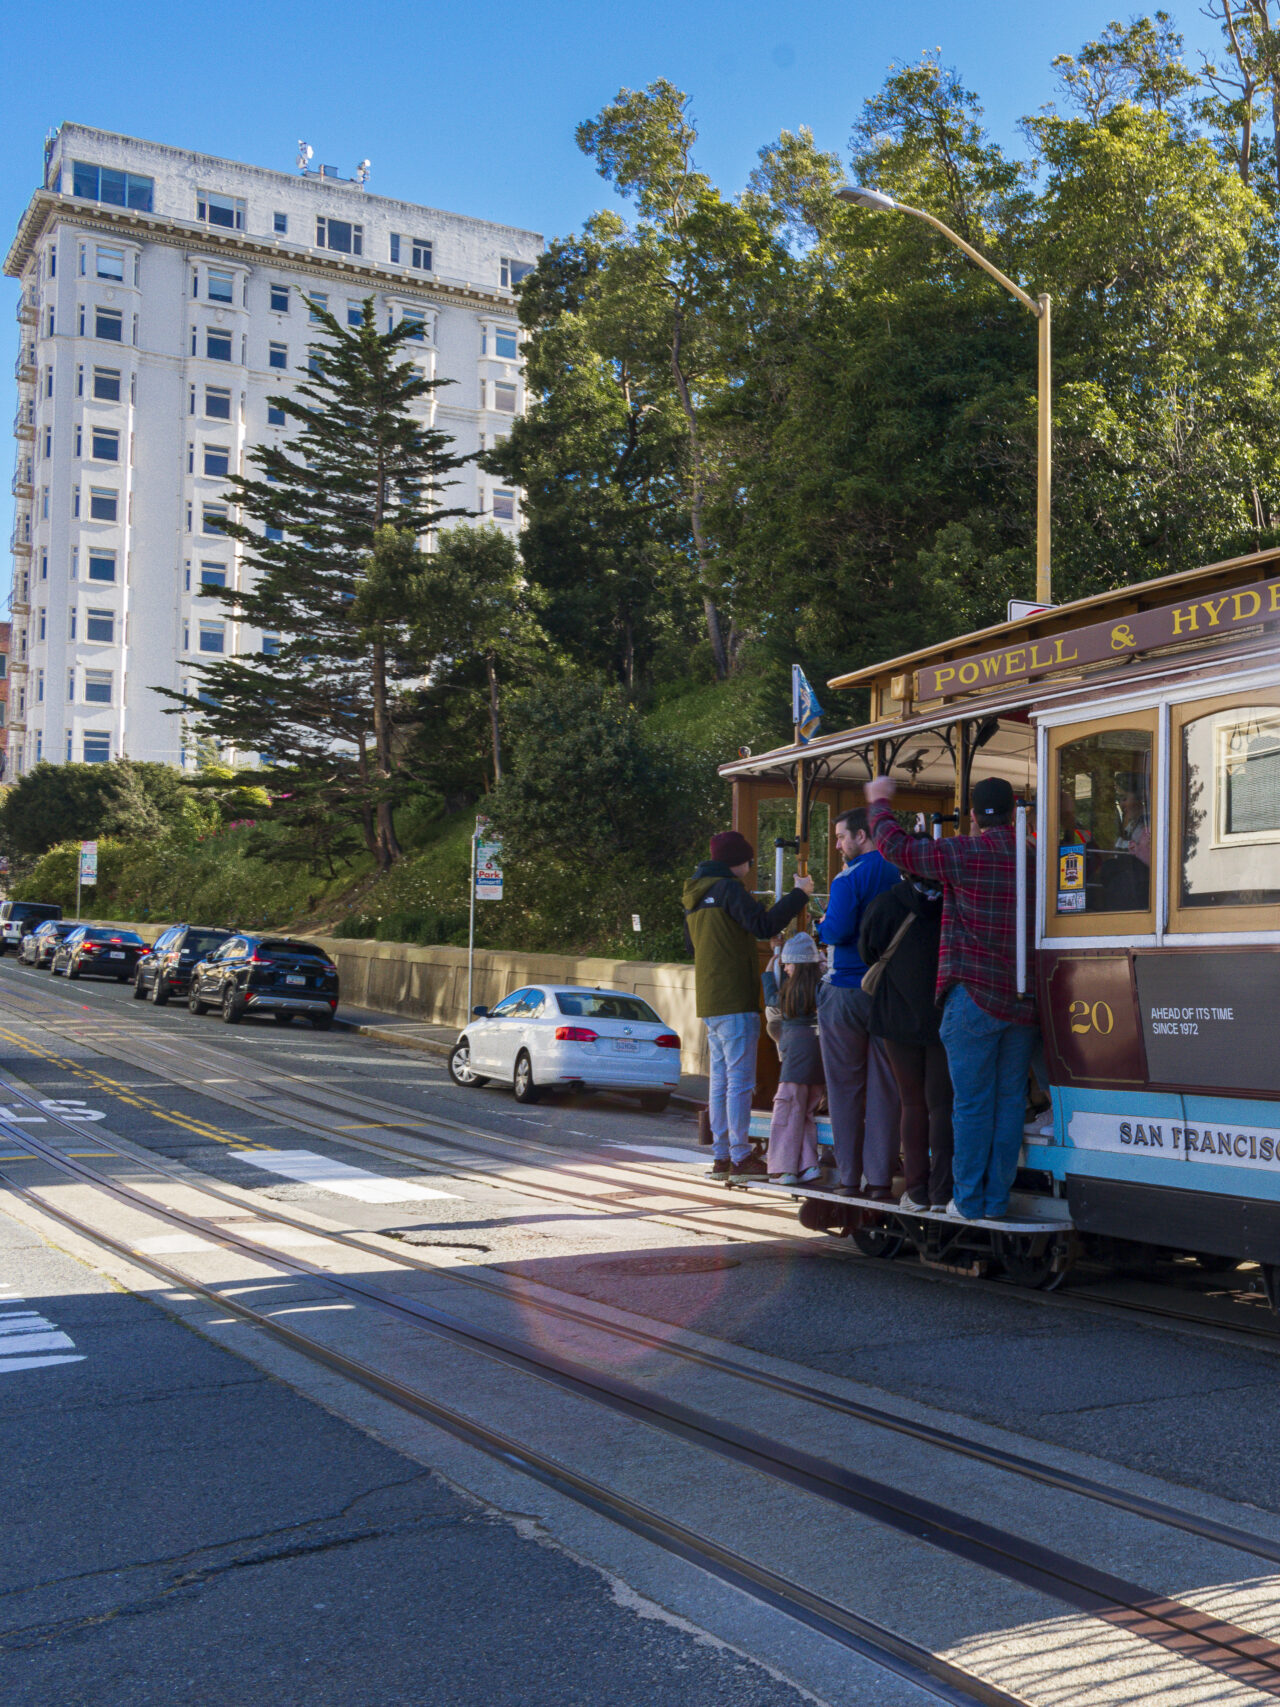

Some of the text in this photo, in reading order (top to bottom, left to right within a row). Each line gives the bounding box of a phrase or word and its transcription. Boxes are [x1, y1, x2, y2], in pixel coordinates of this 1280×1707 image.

[934, 638, 1078, 691] POWELL
[1111, 624, 1136, 651] &
[478, 870, 501, 878] Park
[1069, 1000, 1114, 1035] 20
[1151, 1007, 1234, 1020] AHEAD OF ITS TIME
[1153, 1022, 1199, 1035] SINCE 1972
[1120, 1121, 1163, 1148] SAN
